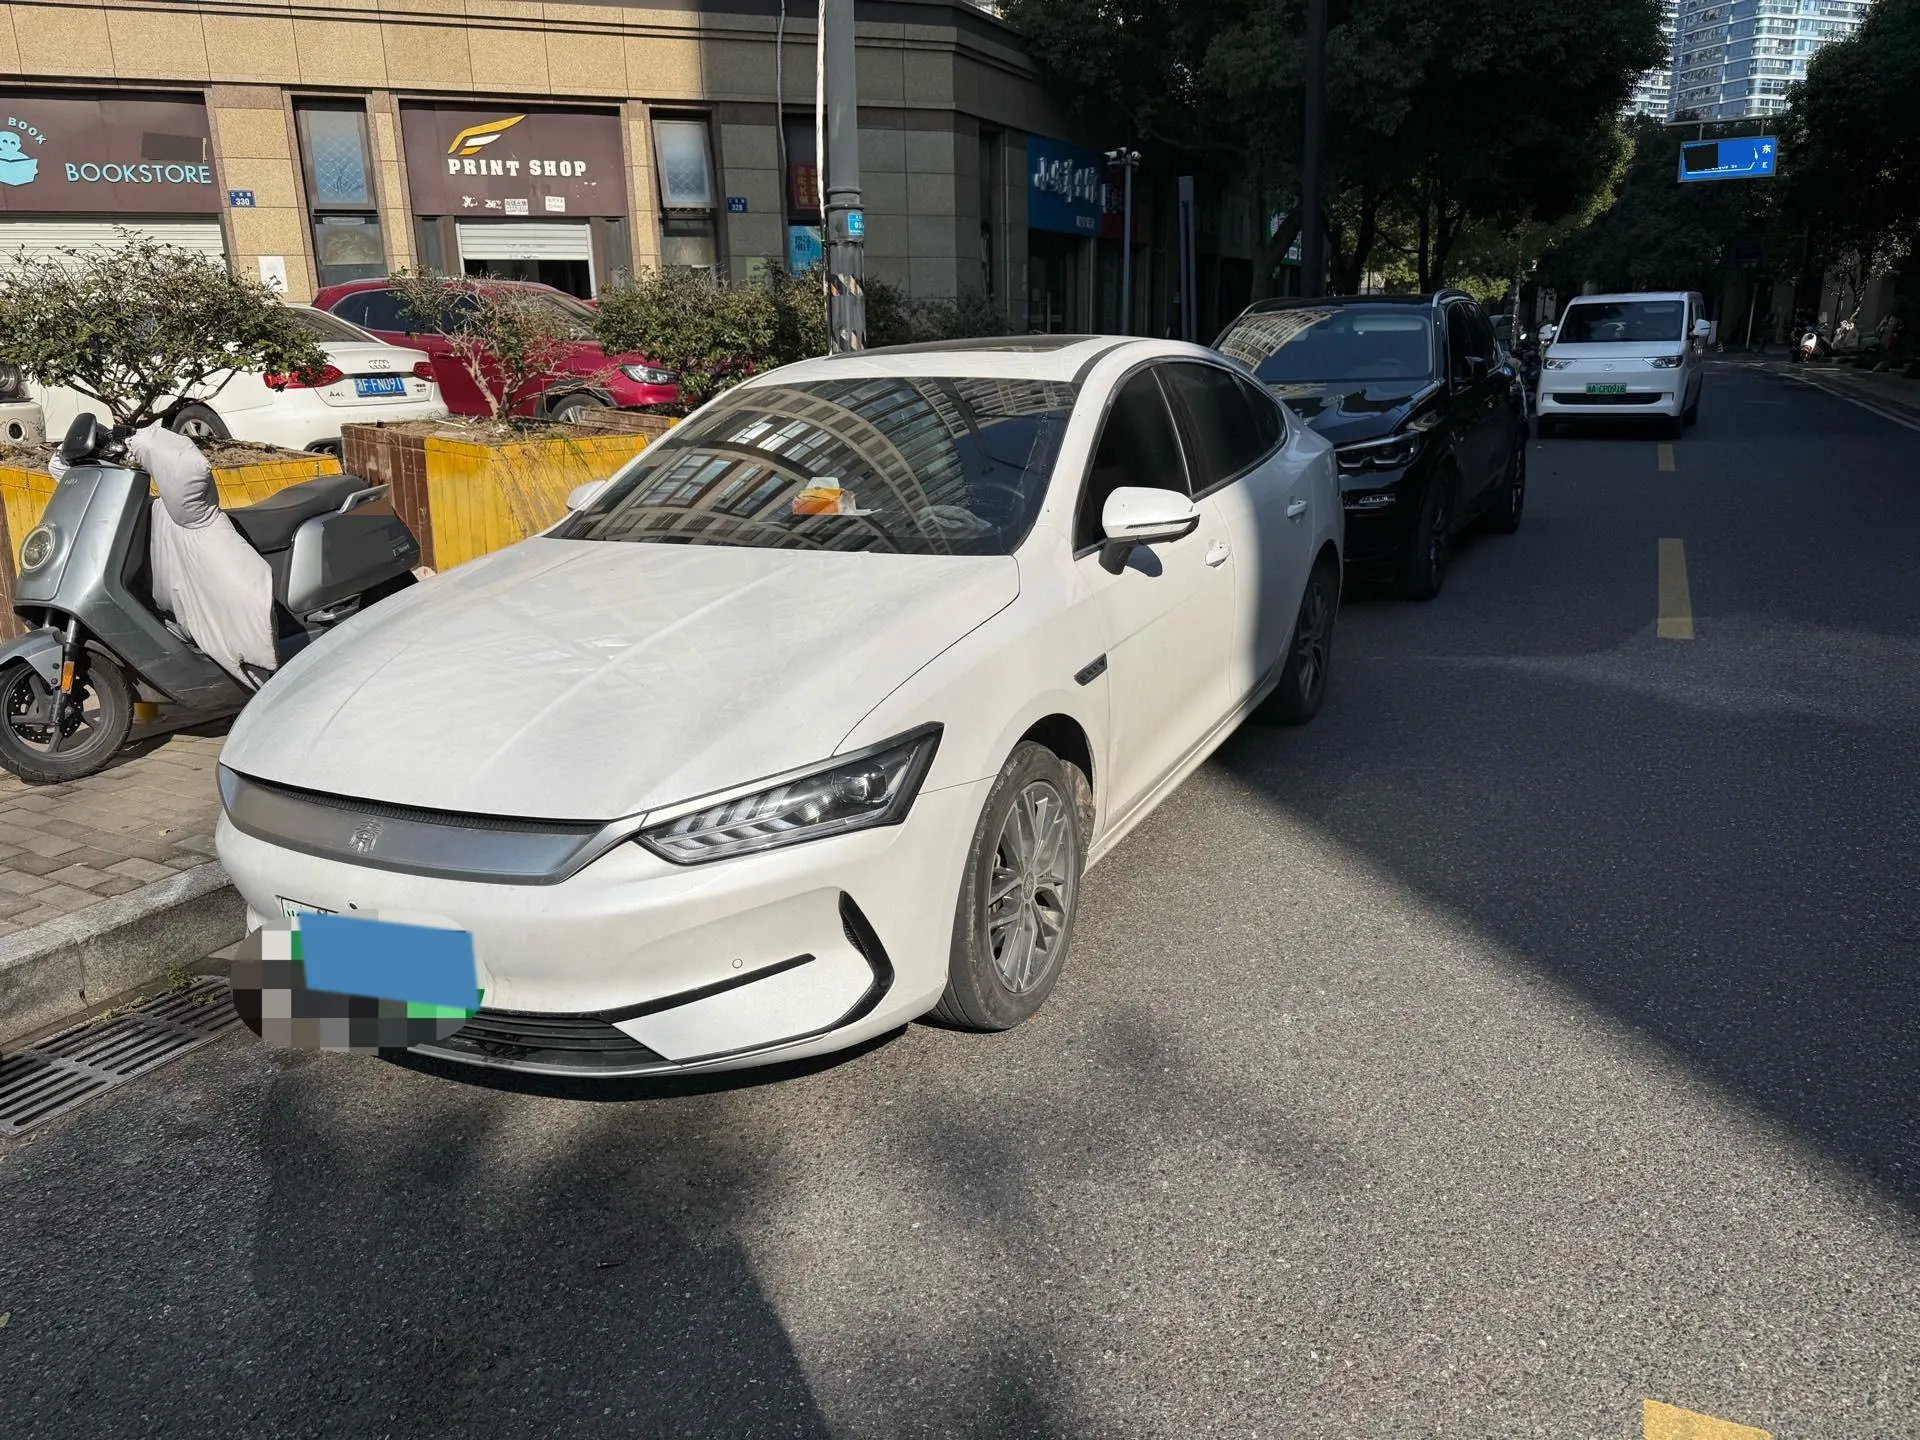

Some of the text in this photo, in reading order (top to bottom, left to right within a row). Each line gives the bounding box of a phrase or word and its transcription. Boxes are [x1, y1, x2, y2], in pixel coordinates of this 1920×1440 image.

[8, 117, 47, 145] BOOK
[65, 163, 212, 184] BOOKSTORE
[447, 158, 587, 177] PRINT SHOP
